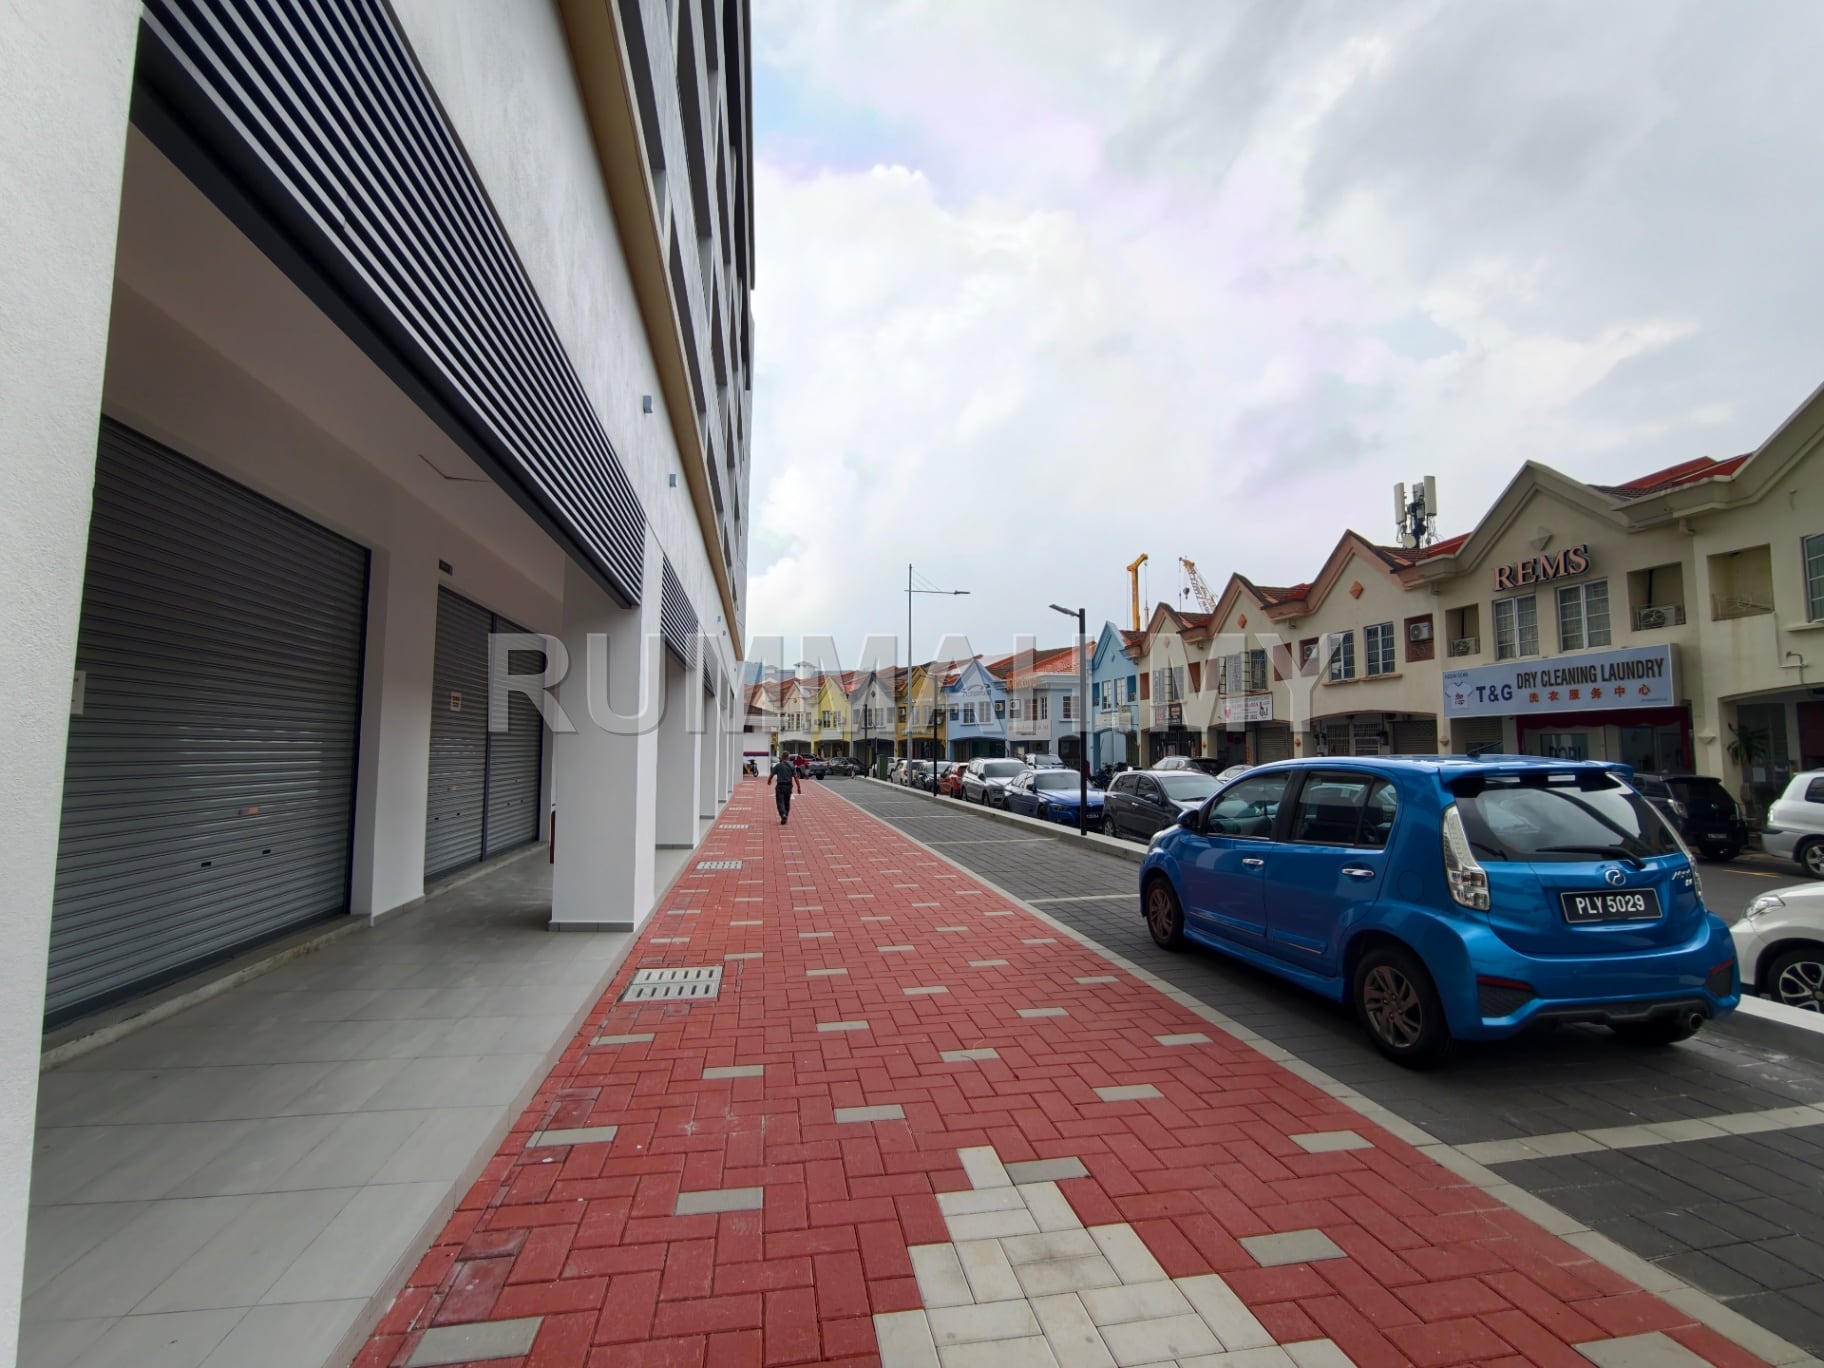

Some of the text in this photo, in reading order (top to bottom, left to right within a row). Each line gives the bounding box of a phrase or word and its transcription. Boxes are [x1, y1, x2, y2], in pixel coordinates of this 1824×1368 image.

[1494, 544, 1590, 592] REMS
[1516, 658, 1664, 690] DRY CLEANING LAUNDRY
[1476, 684, 1513, 703] T&G
[1576, 894, 1646, 915] PLY 5029
